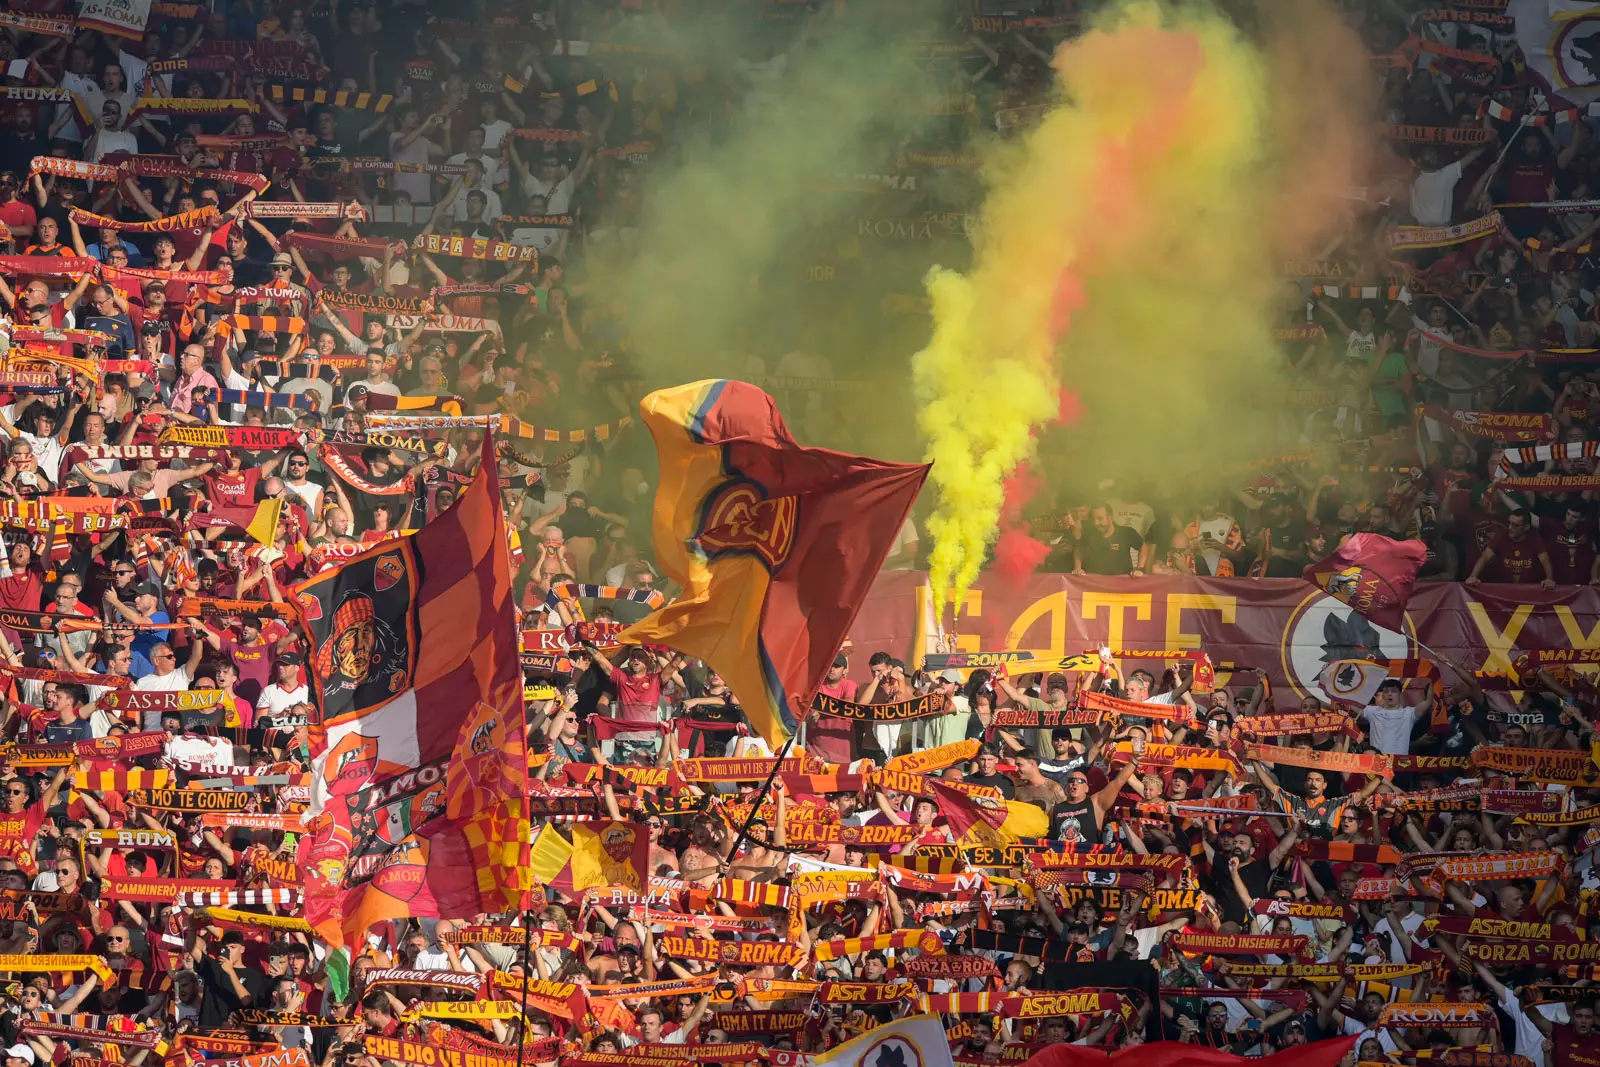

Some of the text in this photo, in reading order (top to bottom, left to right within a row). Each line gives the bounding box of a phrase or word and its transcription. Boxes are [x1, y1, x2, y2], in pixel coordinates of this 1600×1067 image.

[84, 4, 98, 14] AS
[103, 7, 145, 26] ROMA
[152, 60, 188, 73] OMA
[8, 87, 72, 101] ROMA
[365, 162, 393, 170] CAPITANO
[143, 213, 208, 231] ROMA
[858, 218, 932, 240] ROMA
[416, 236, 532, 258] ORZA ROM
[265, 287, 300, 298] ROMA
[323, 289, 416, 310] MAGICA ROMA
[118, 362, 135, 372] 10
[0, 373, 51, 385] RINHO
[416, 416, 475, 428] ROMA
[334, 429, 426, 452] AS ROMA
[82, 446, 152, 458] ROMA
[330, 454, 369, 490] MAGICA
[217, 483, 245, 491] QATAR
[326, 543, 375, 557] ROM
[1359, 578, 1379, 613] ROMA
[520, 656, 551, 666] ROMA
[1539, 650, 1573, 661] MAI
[126, 691, 225, 708] AS ROMA
[819, 695, 839, 713] VE
[844, 703, 866, 718] SE
[996, 711, 1098, 726] ROMA TI AMO
[1507, 713, 1545, 724] roma
[26, 749, 69, 760] ROMA
[900, 742, 975, 772] AS ROMA
[200, 763, 266, 776] ROMA
[585, 767, 667, 785] AOMA
[152, 791, 249, 808] MO' TE GONFIO
[730, 808, 813, 821] ORZA OMA
[226, 818, 284, 830] MAI SOLA MAI
[89, 832, 173, 846] S ROM
[791, 825, 913, 842] DAJE ROMA
[975, 847, 994, 862] SE
[1041, 853, 1181, 869] MAI SOLA MAI
[256, 859, 297, 881] ROMA
[1447, 859, 1550, 875] FORZA ROMA
[116, 880, 176, 896] CAMMINERÒ
[648, 878, 683, 889] OMA
[798, 881, 860, 896] OMA TI
[611, 889, 671, 904] ROMA
[1468, 918, 1551, 939] ASROMA
[462, 931, 501, 943] ULTRAS
[1173, 933, 1289, 949] CAMMINERÒ INSIEME A
[671, 938, 791, 963] DAJE ROMA
[1469, 944, 1531, 961] FORZA
[905, 958, 1000, 972] FORZA ROM
[1295, 963, 1339, 976] ROMA
[366, 967, 431, 985] ortacci
[828, 982, 917, 1001] ASR 192
[1020, 993, 1100, 1015] ASROMA
[1390, 1008, 1479, 1022] ROMA
[366, 1036, 434, 1065] CHE DIO
[1004, 1047, 1030, 1060] MAI
[1445, 1052, 1529, 1067] ASROM
